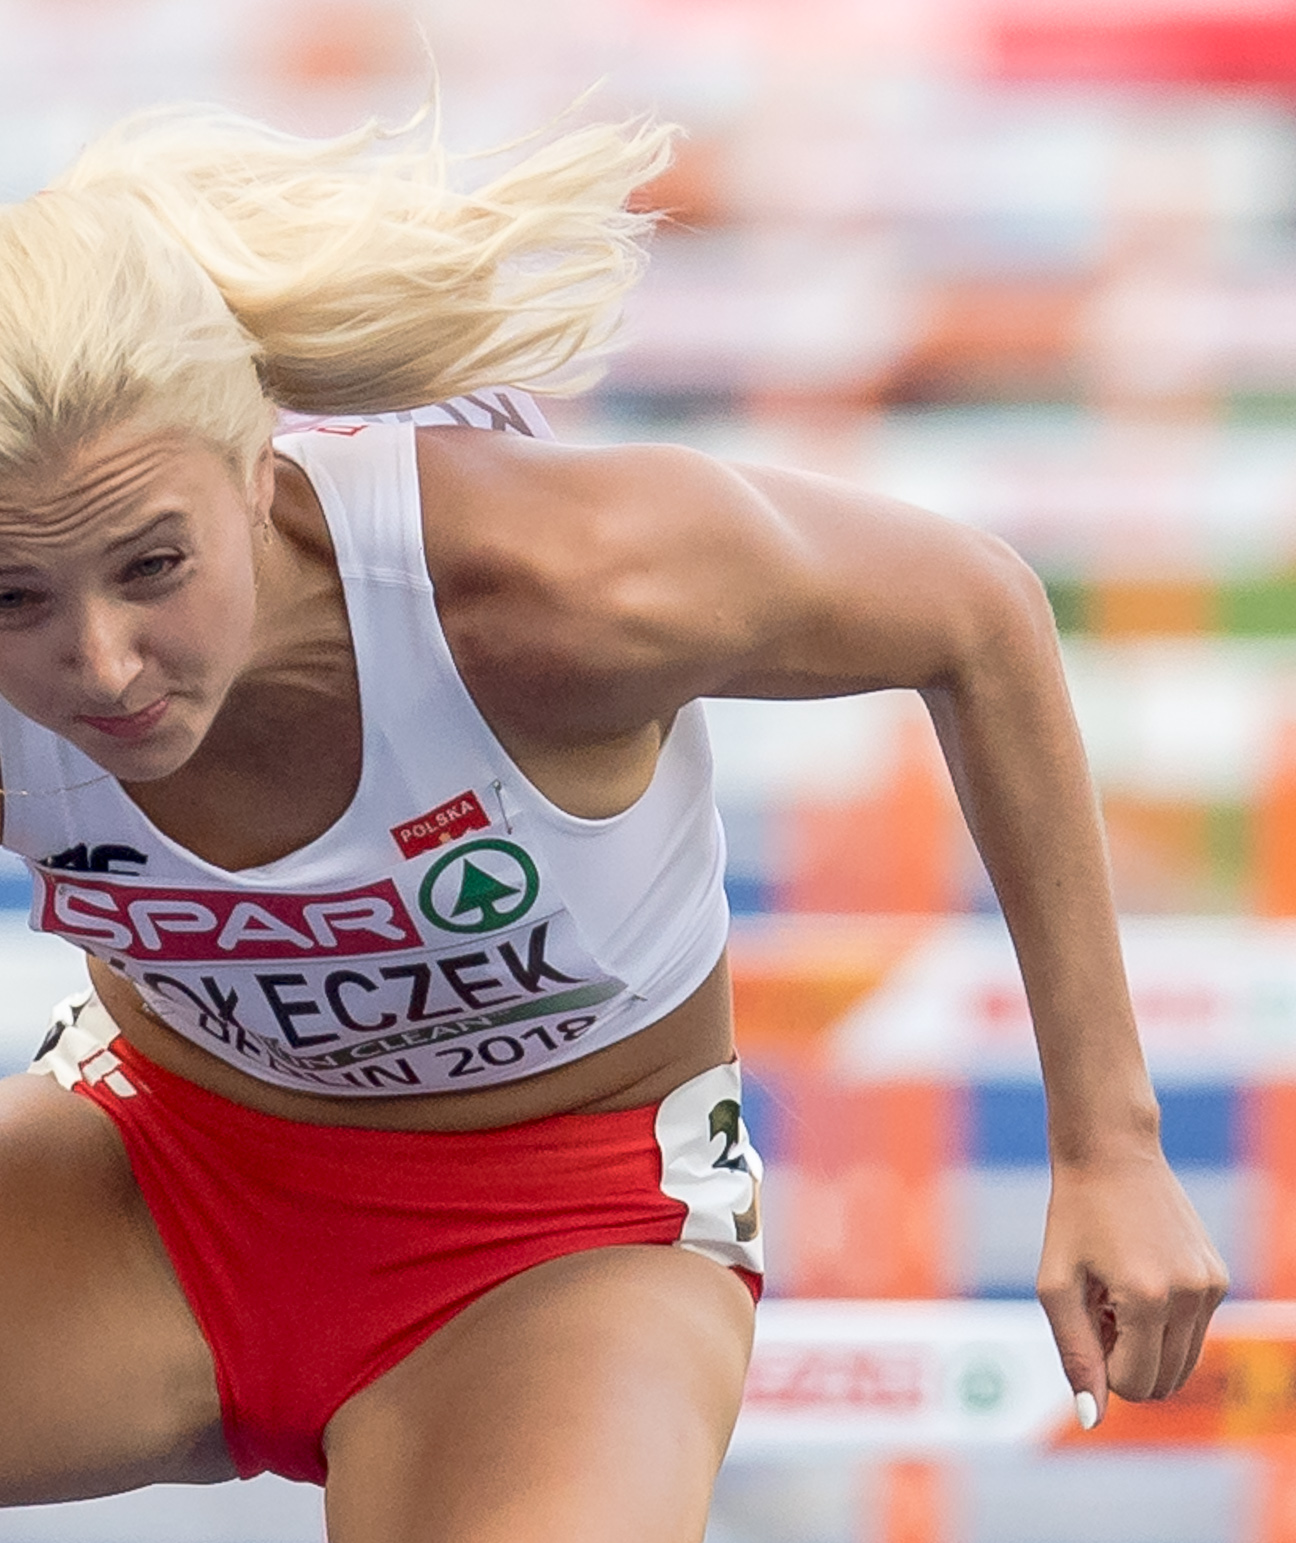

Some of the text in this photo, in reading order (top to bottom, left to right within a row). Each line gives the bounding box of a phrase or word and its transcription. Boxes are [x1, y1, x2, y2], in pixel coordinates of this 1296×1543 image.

[400, 800, 475, 843] POLSKA
[54, 882, 406, 951] SPAR
[349, 1014, 492, 1058] CLEAN
[435, 1014, 598, 1080] 2018
